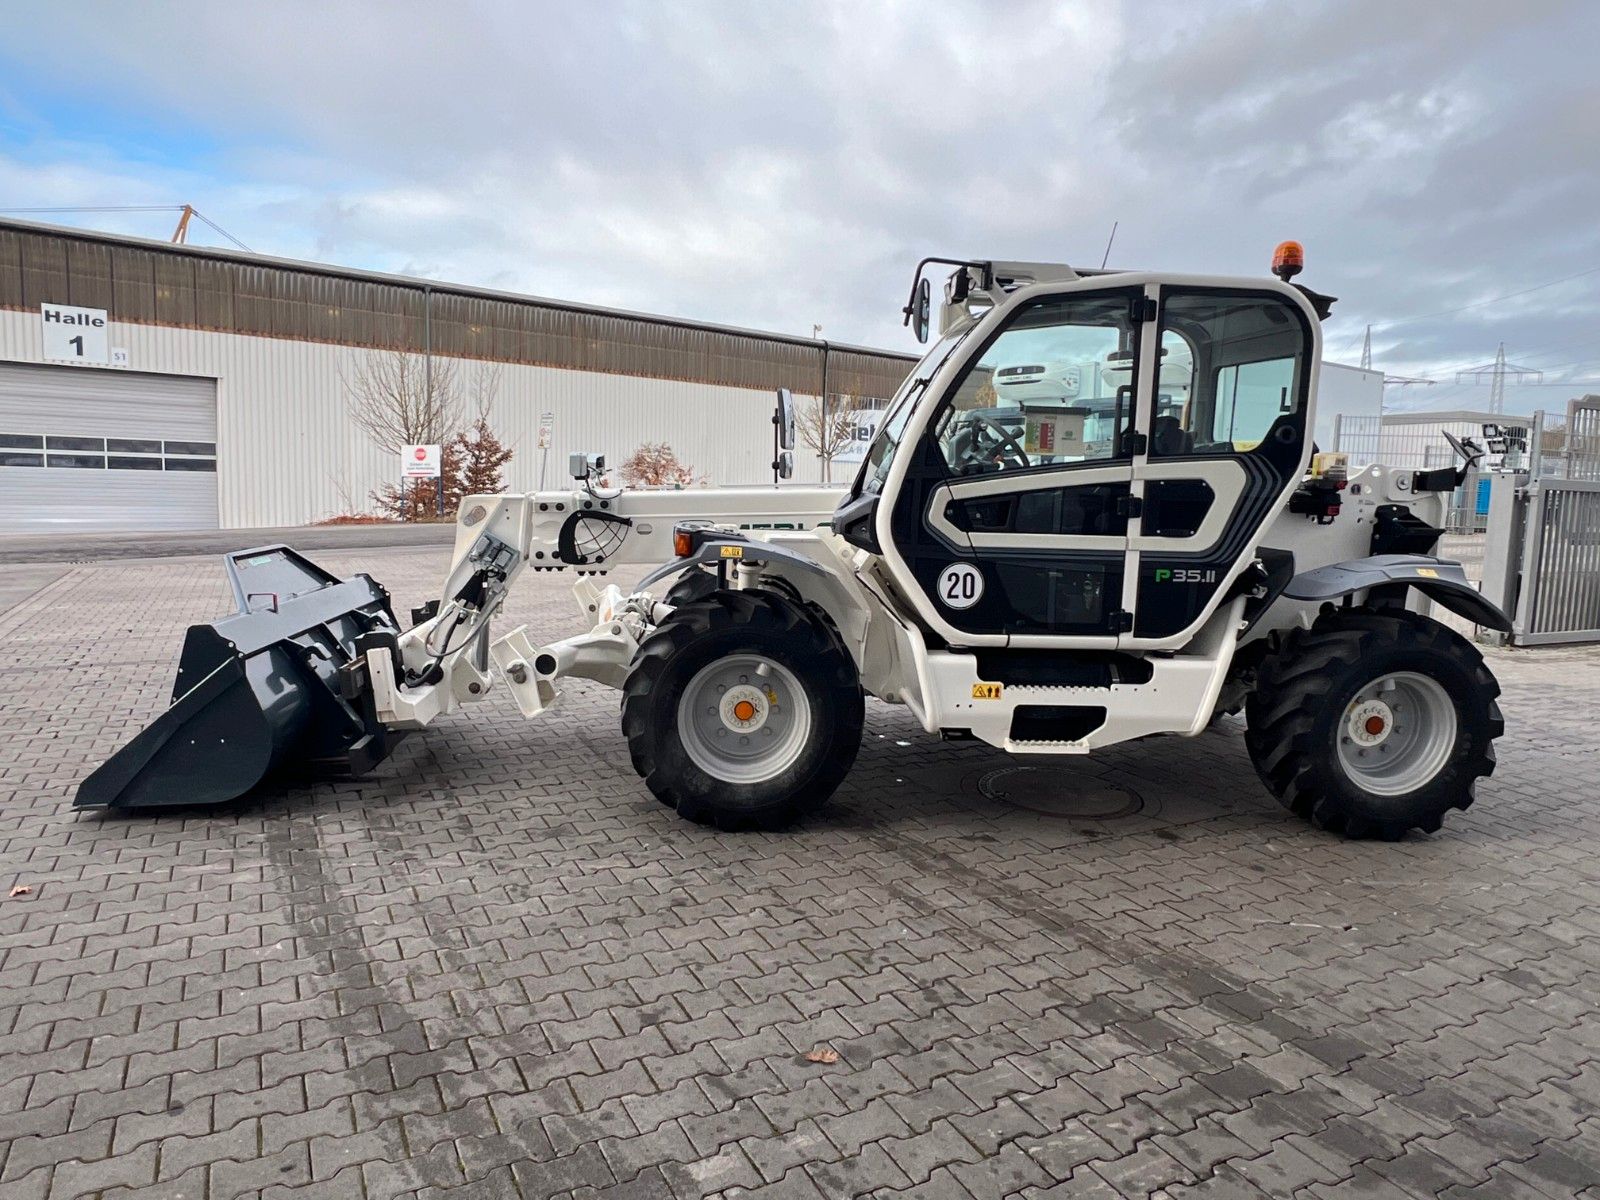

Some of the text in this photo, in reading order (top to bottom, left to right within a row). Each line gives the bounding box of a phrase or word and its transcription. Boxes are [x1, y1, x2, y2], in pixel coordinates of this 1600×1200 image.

[44, 310, 105, 327] Halle
[69, 335, 83, 356] 1
[947, 572, 975, 599] 20
